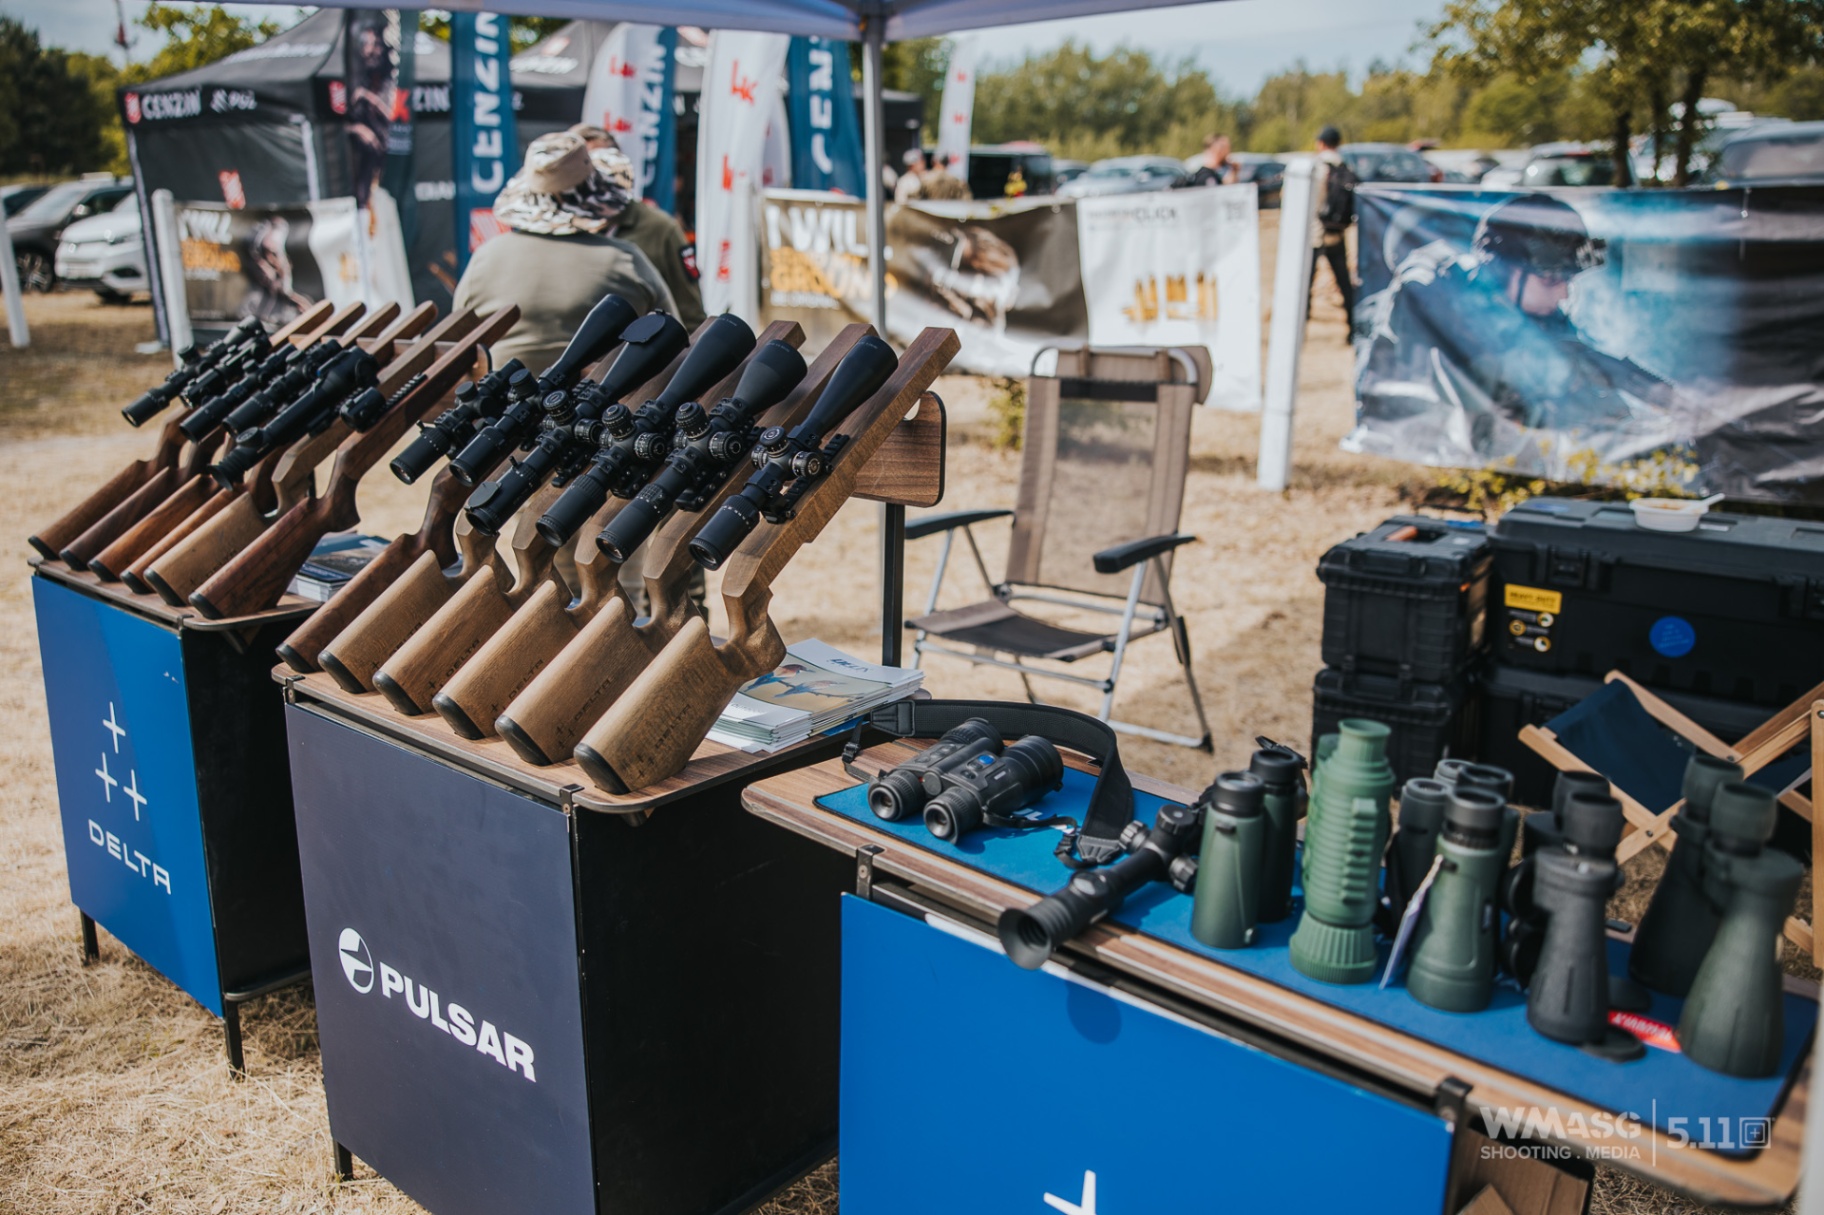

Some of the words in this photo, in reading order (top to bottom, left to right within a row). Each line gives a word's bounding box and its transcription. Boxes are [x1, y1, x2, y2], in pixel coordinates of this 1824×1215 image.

[141, 88, 202, 120] CENZIN
[471, 11, 505, 194] CENZIN
[787, 205, 894, 261] WIL
[446, 638, 480, 677] DELTA
[509, 658, 545, 700] DELTA
[573, 677, 613, 722] DELTA
[88, 818, 171, 895] DELTA
[380, 961, 536, 1083] PULSAR
